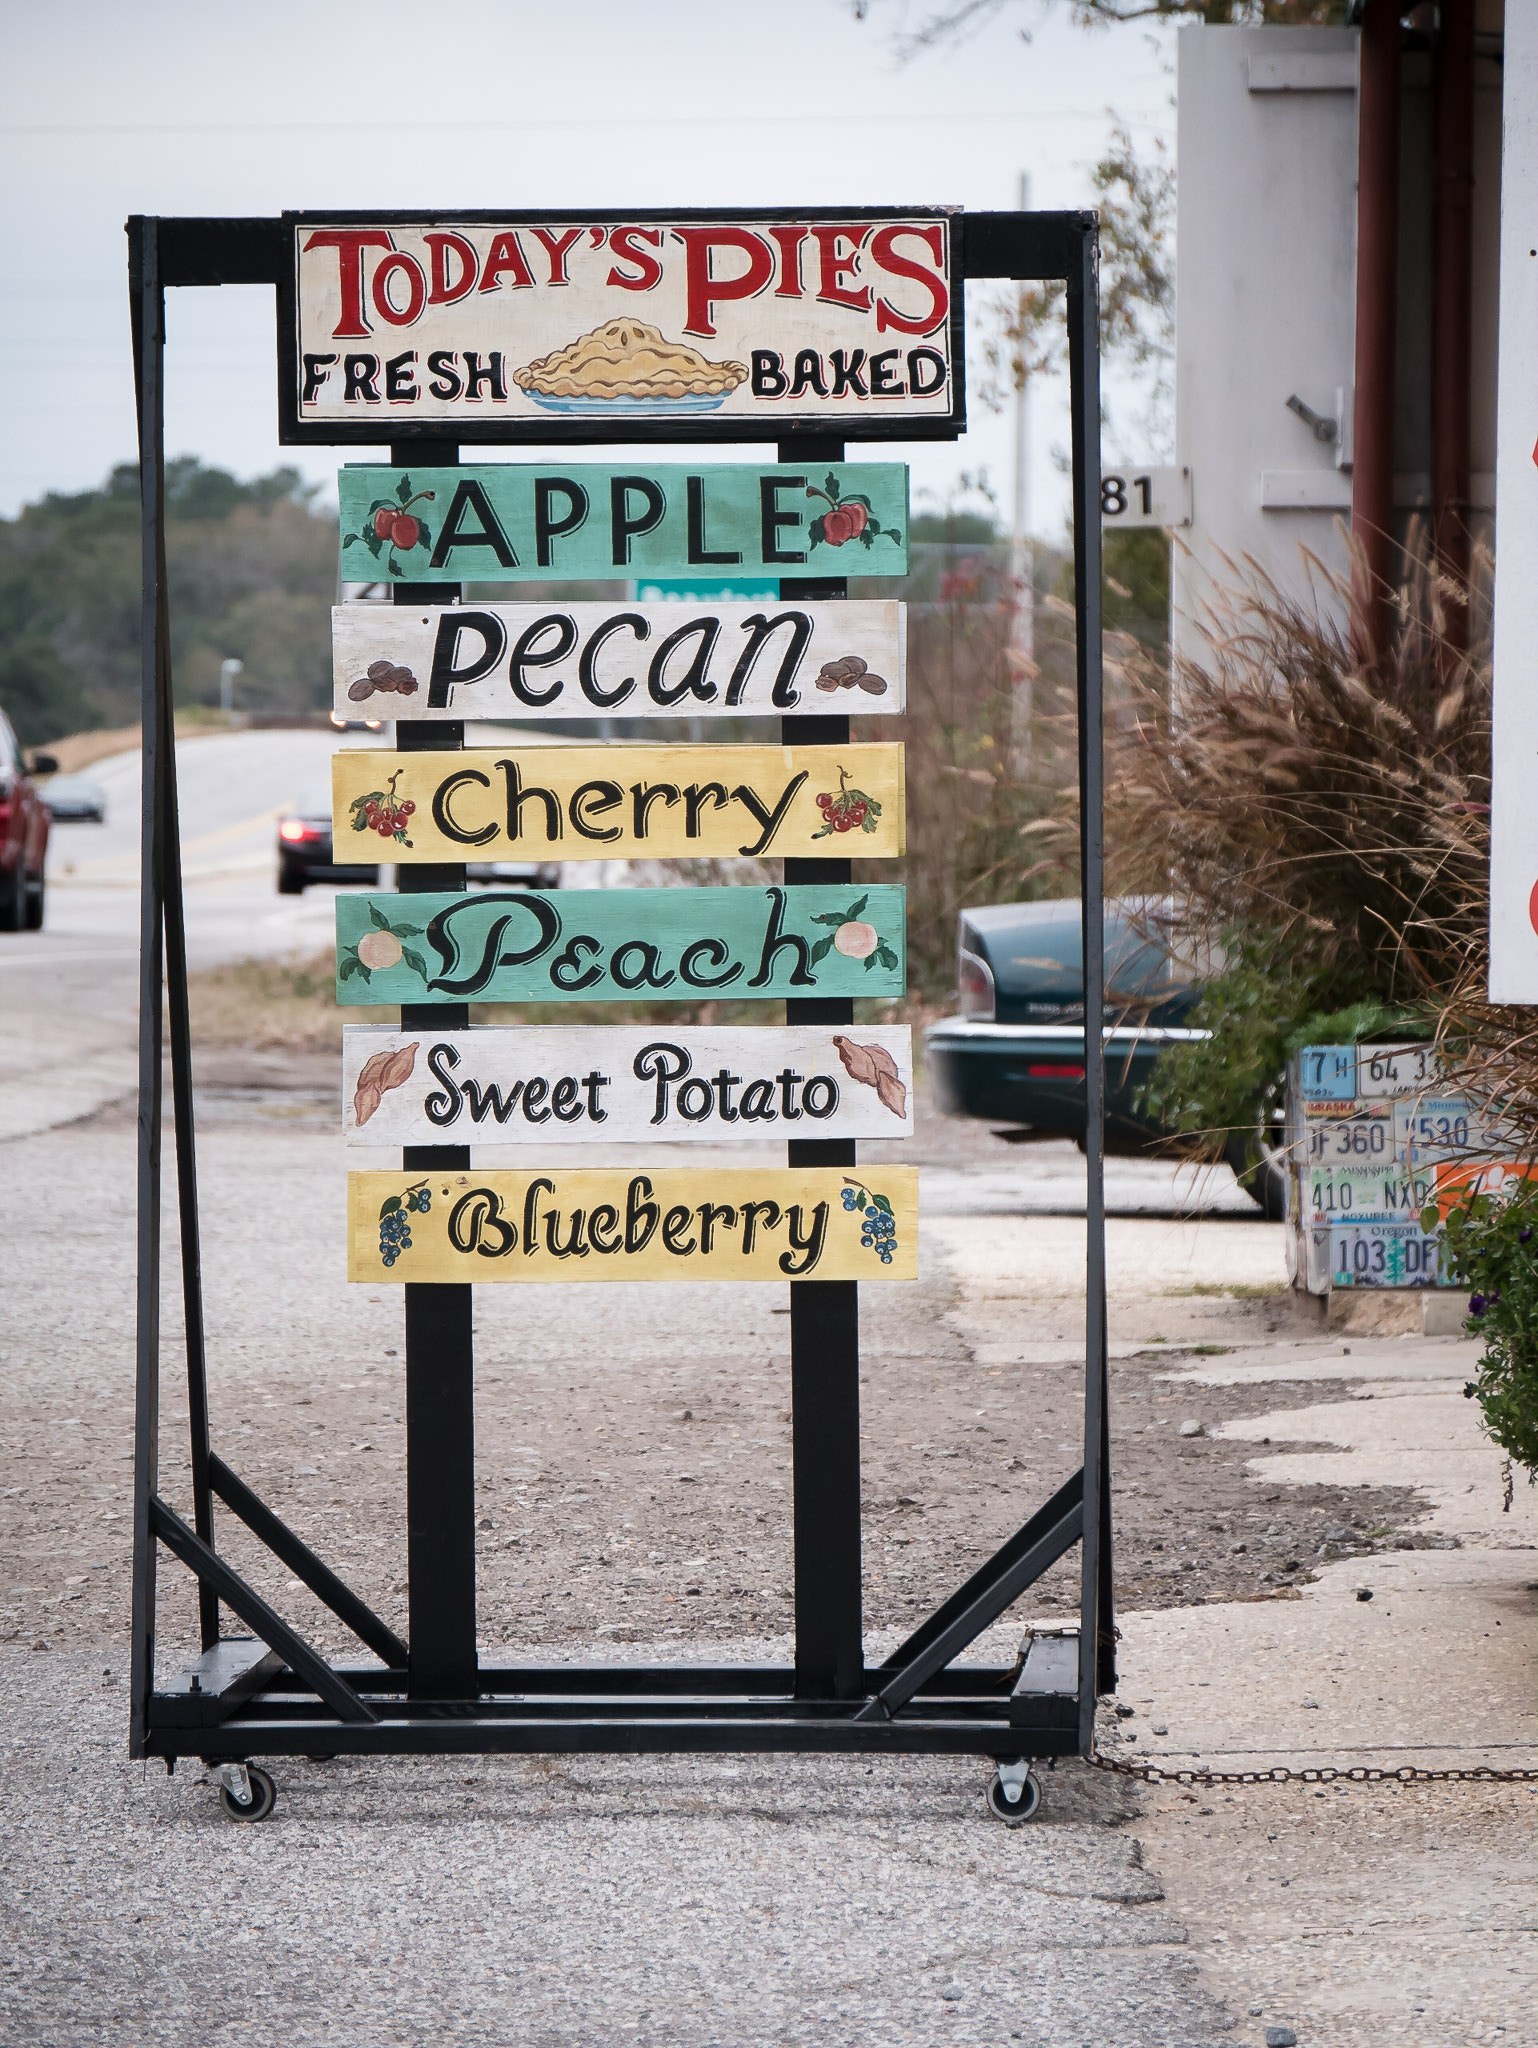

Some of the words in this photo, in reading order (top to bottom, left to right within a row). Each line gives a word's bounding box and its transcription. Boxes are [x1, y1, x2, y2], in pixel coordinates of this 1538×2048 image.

[302, 226, 665, 339] TODAY'S
[673, 225, 949, 338] PIES
[302, 350, 508, 405] FRESH
[750, 346, 947, 399] BAKED
[428, 475, 808, 569] APPLE
[431, 759, 810, 857] Cherry
[426, 886, 820, 996] Peach
[424, 1043, 612, 1128] Sweet
[631, 1041, 841, 1126] Potato
[447, 1175, 830, 1276] Blueberry
[1311, 1182, 1352, 1211] 410
[1339, 1239, 1387, 1273] 103
